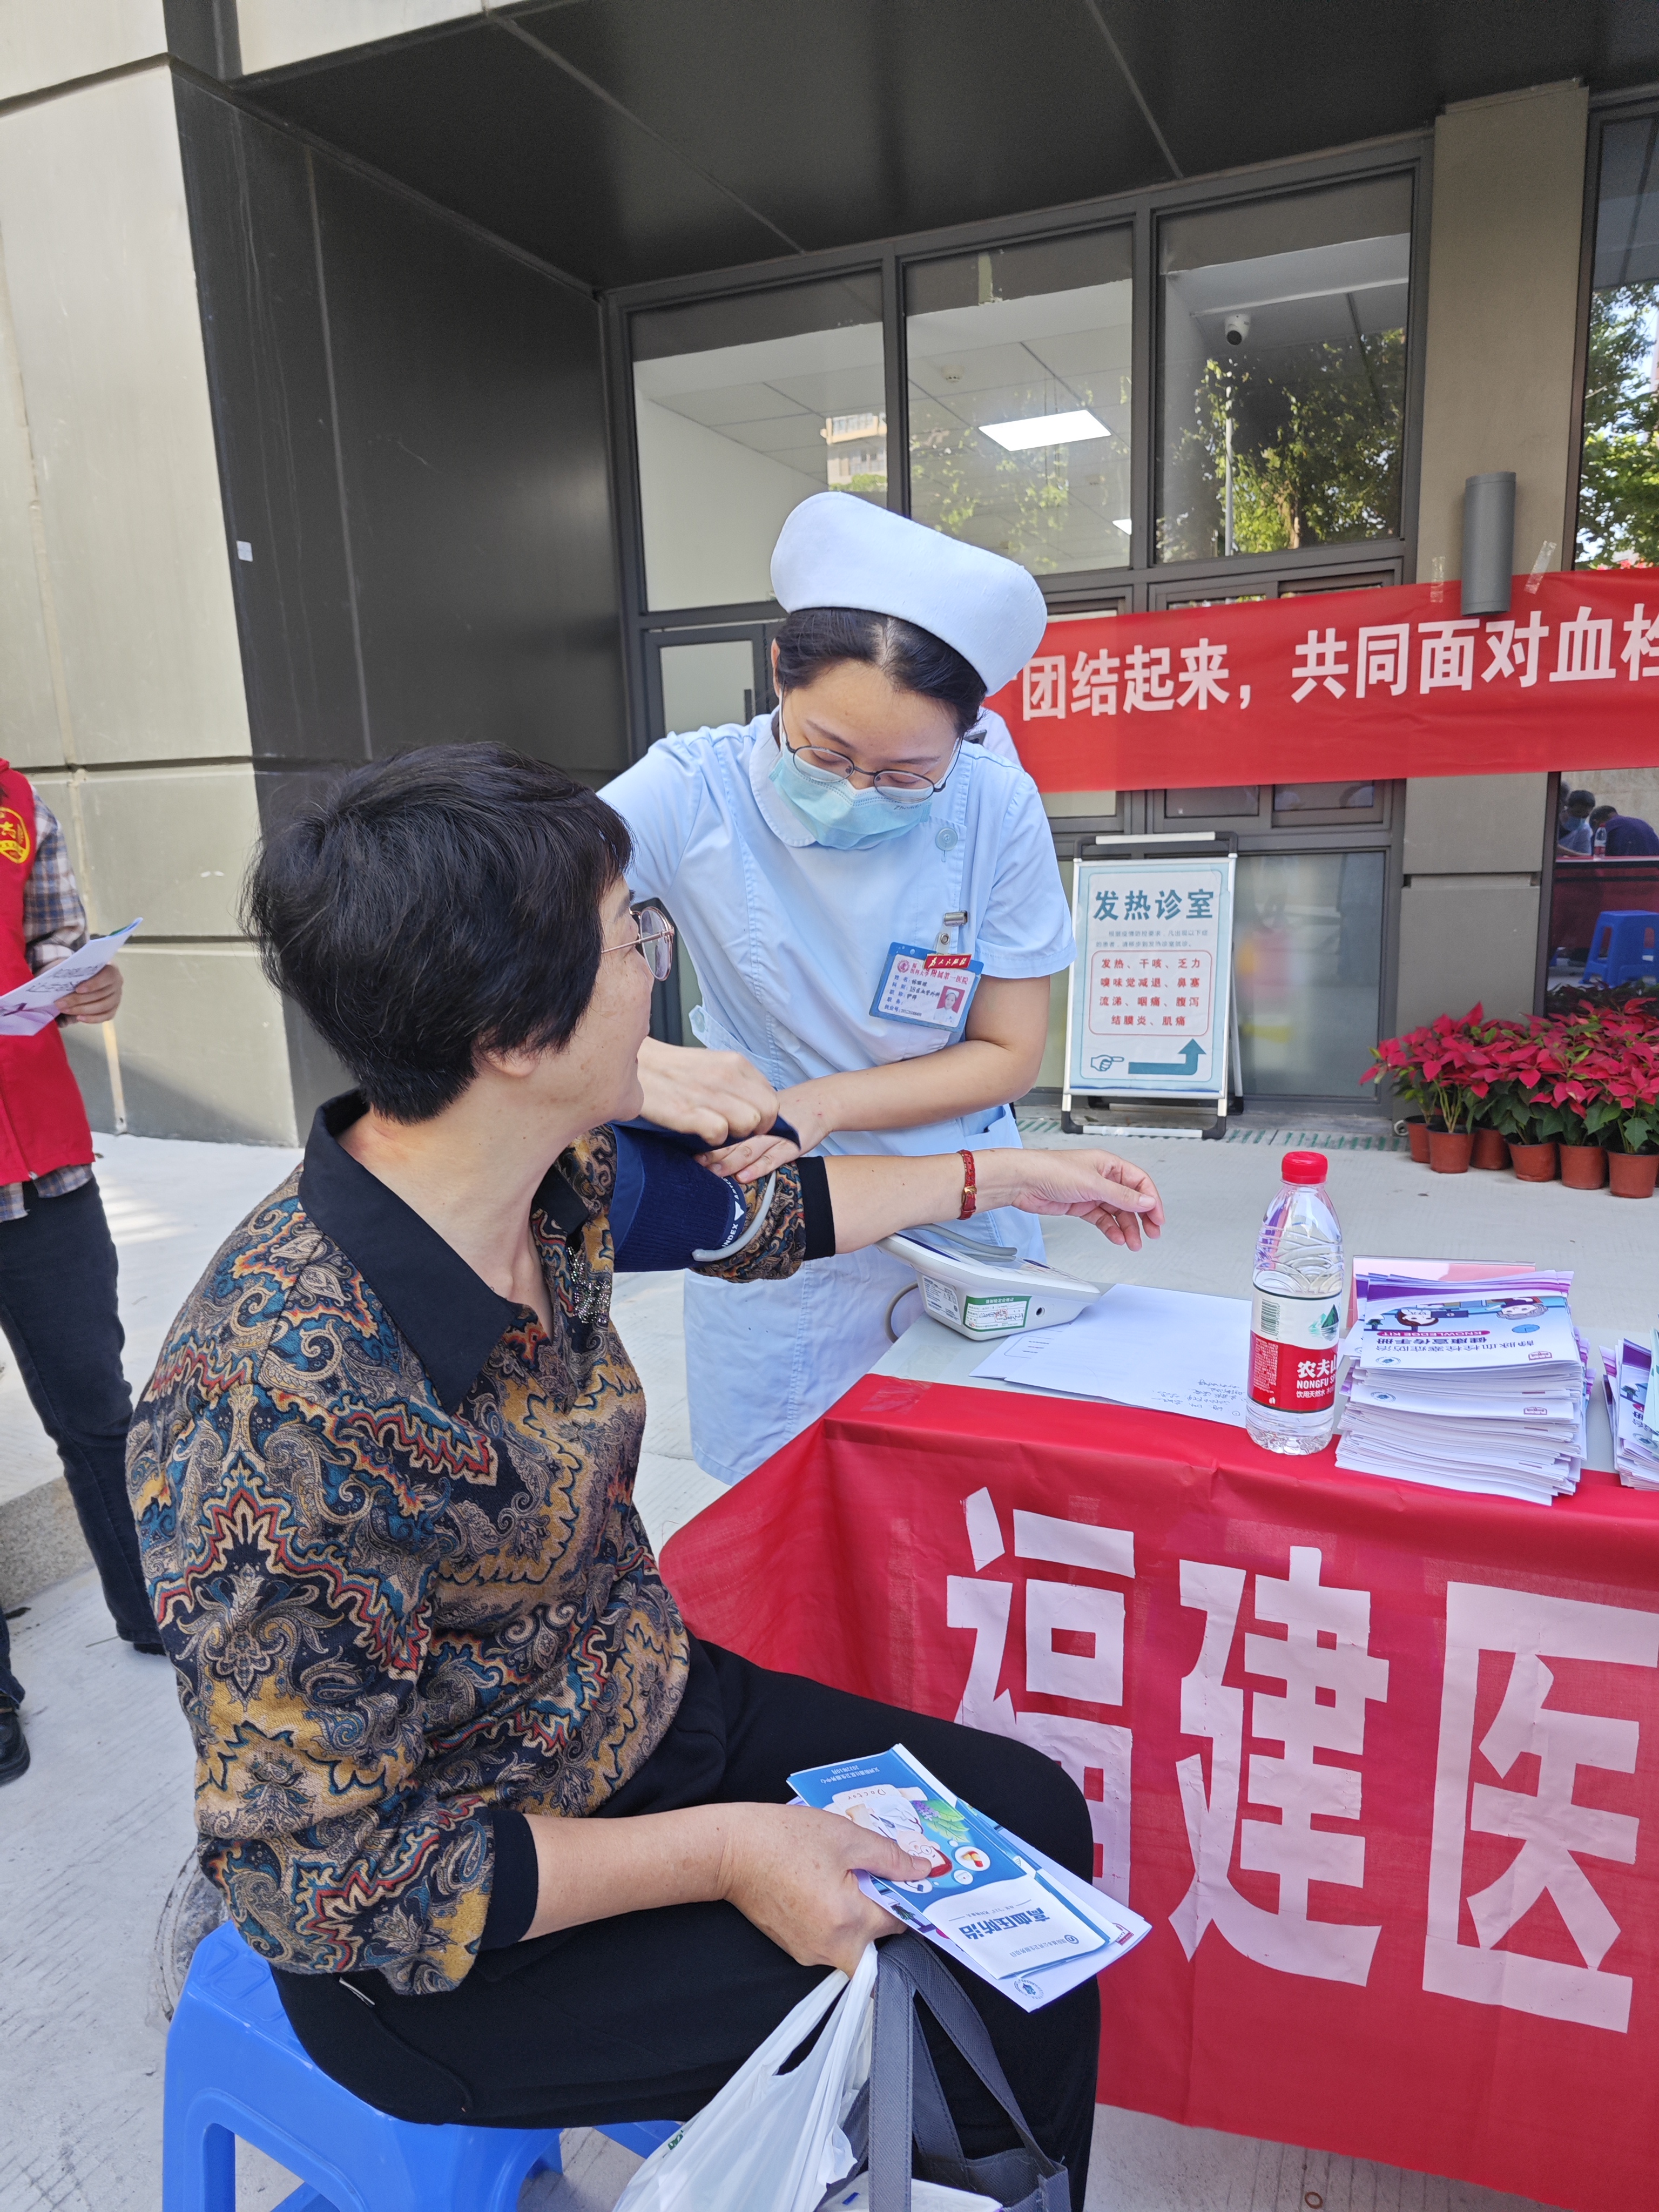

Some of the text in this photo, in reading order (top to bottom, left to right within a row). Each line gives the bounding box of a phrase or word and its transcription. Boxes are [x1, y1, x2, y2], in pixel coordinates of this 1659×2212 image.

[1092, 888, 1214, 921] 发热诊室
[1101, 958, 1201, 969] 发热、干咳、乏力
[1100, 996, 1199, 1007] 流涕、咽痛、腹泻
[1111, 1015, 1186, 1026] 结膜炎、肌痛
[721, 1223, 739, 1247] INDEX
[1296, 1377, 1329, 1390] NONGFU
[848, 1788, 887, 1800] Doctor
[958, 1907, 1051, 1940] 高血压防治
